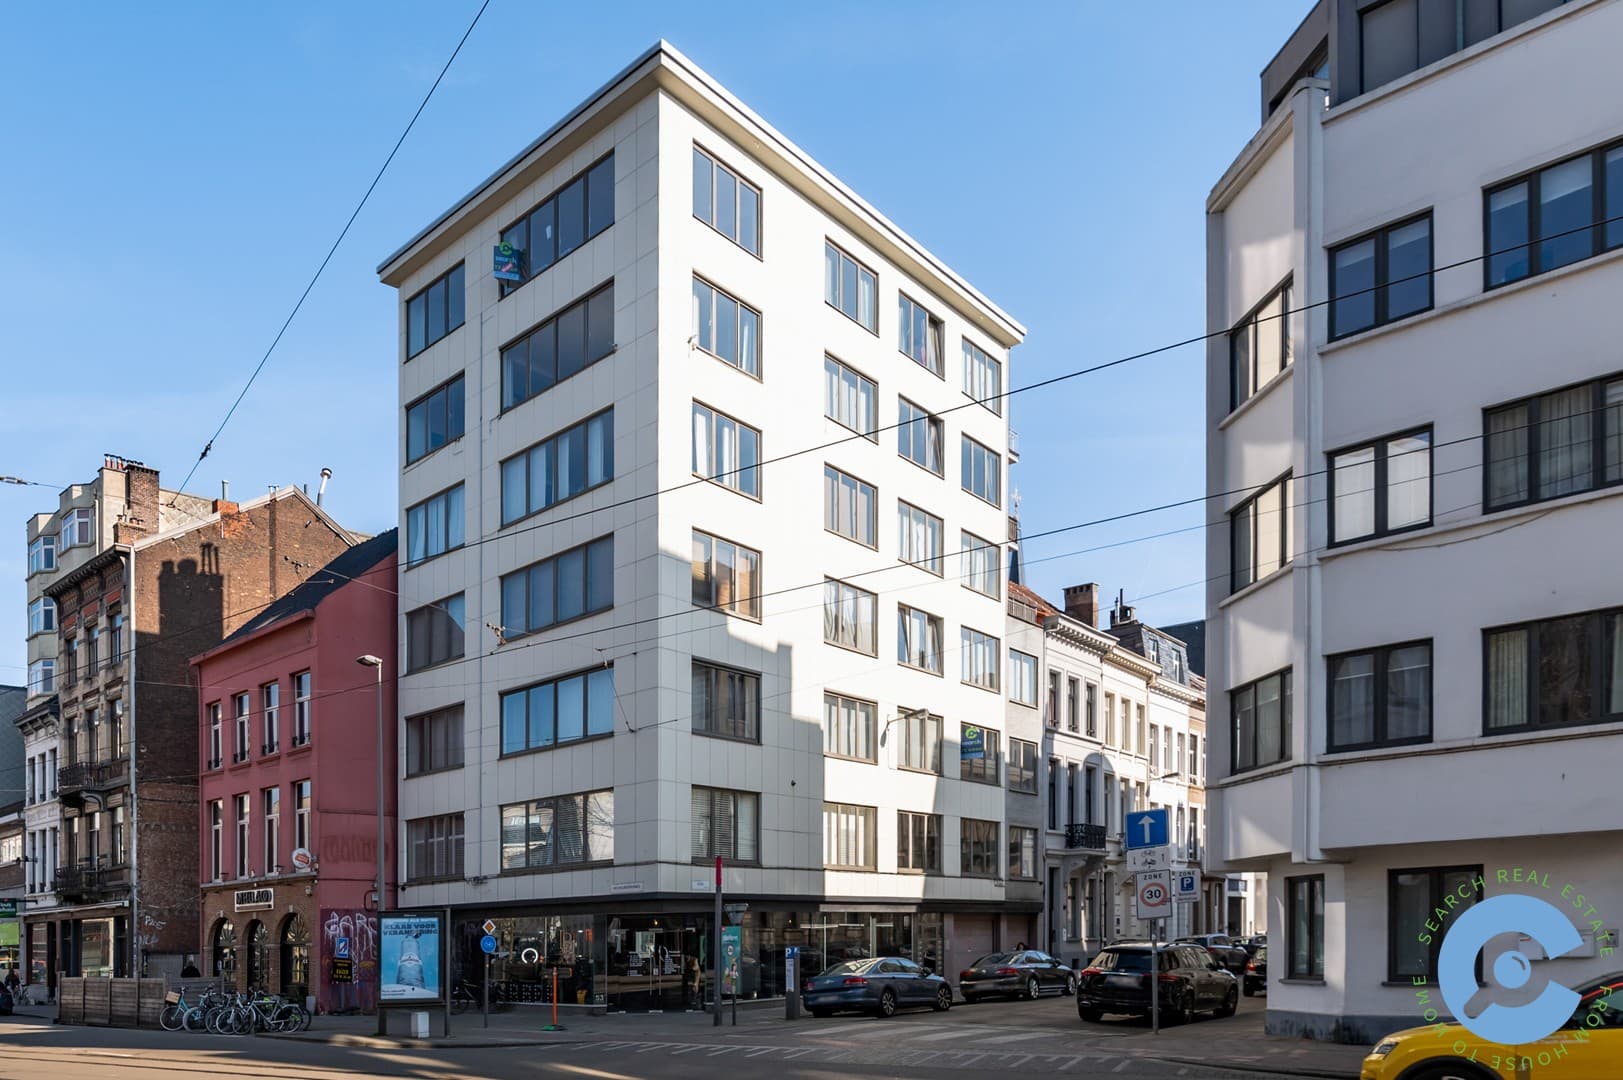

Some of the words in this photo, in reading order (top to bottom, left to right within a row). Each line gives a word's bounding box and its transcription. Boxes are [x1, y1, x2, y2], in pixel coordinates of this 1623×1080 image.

[1183, 878, 1192, 888] P
[1146, 889, 1161, 899] 30
[785, 947, 792, 958] P
